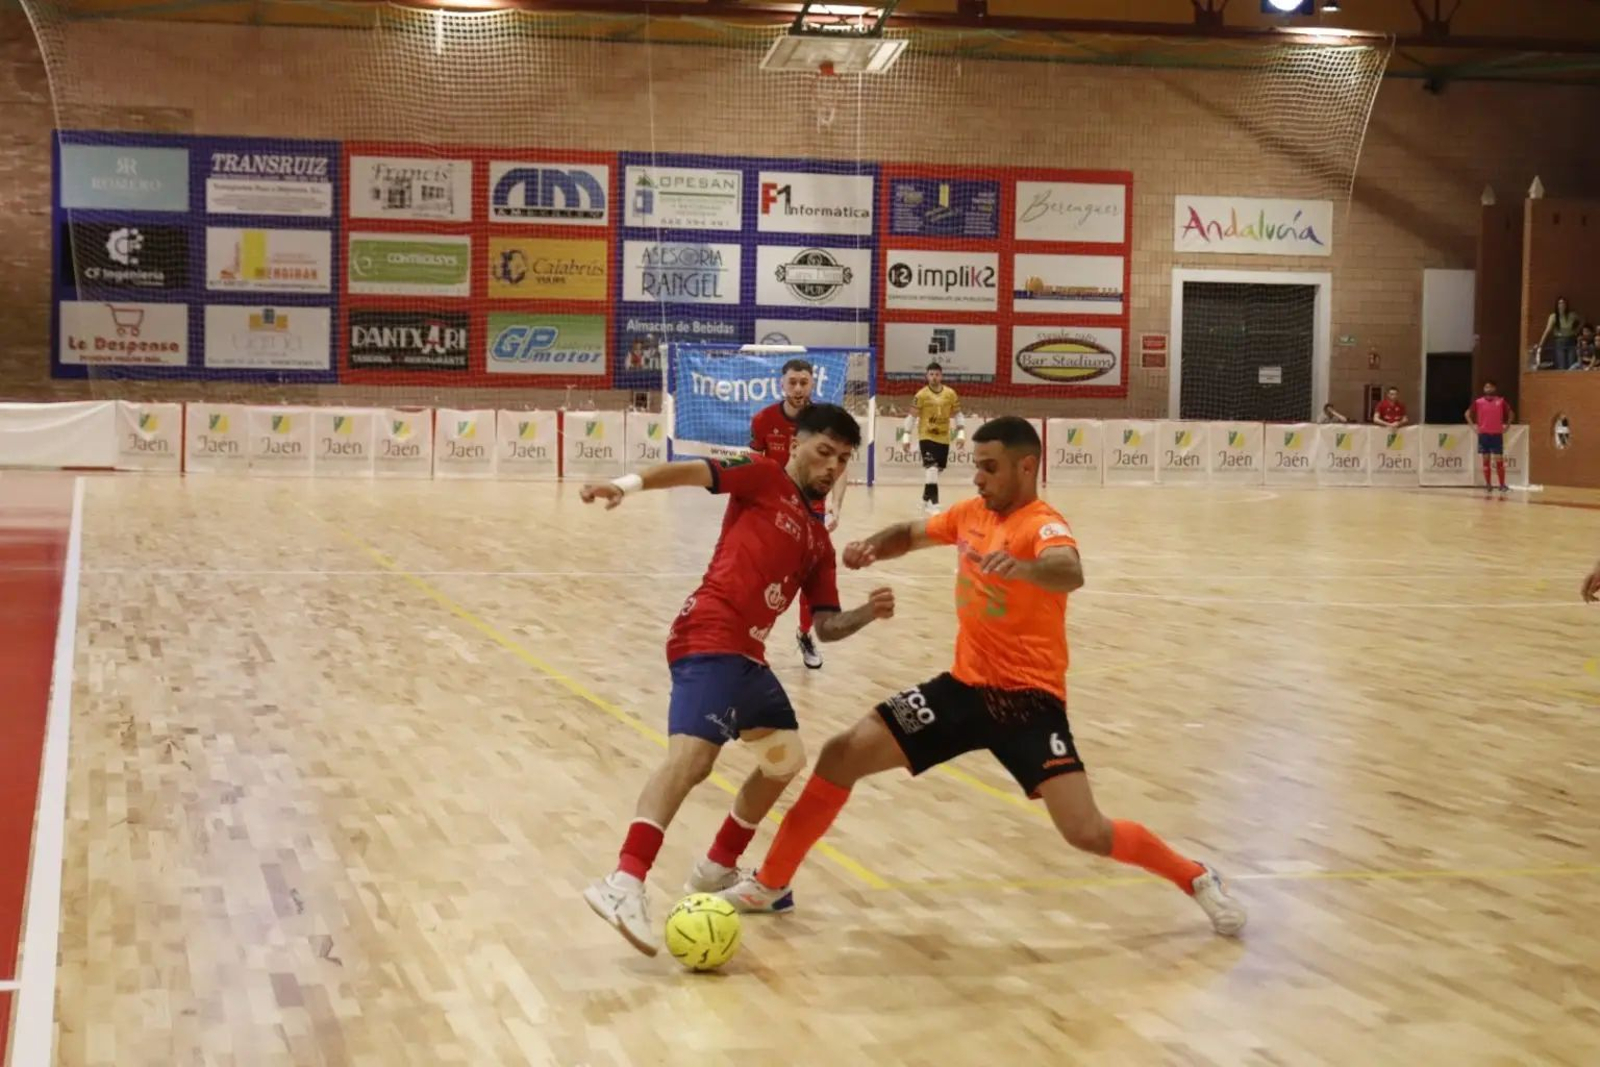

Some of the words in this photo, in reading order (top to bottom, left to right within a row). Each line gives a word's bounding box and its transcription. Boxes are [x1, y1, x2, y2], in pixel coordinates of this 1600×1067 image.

[211, 153, 328, 175] TRANSRUIZ
[659, 176, 736, 189] OPESAN
[1019, 189, 1119, 225] Berenguer
[1182, 205, 1324, 246] Andalucía
[641, 271, 723, 298] RANGEL
[917, 264, 996, 292] implik2
[352, 325, 466, 354] DANTXARI
[676, 321, 690, 333] de
[692, 322, 735, 334] Bebidas
[491, 325, 558, 361] GP
[532, 351, 602, 363] motor
[1021, 354, 1048, 366] Bar
[1051, 354, 1111, 368] Stadium
[1050, 732, 1067, 756] 6
